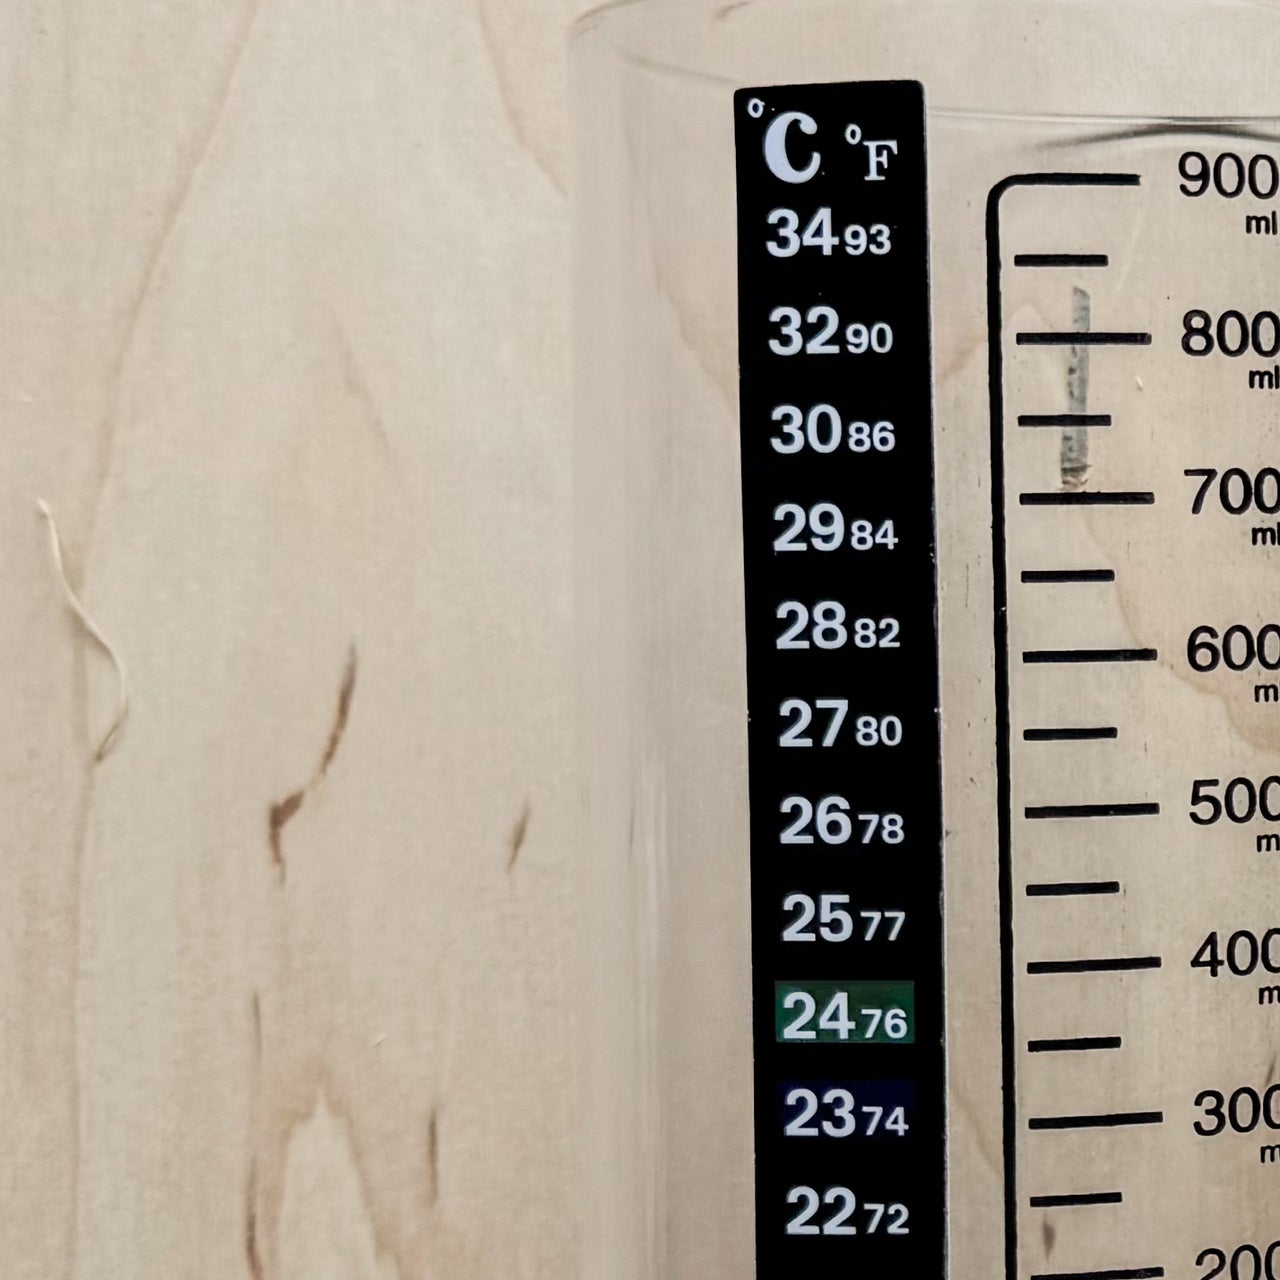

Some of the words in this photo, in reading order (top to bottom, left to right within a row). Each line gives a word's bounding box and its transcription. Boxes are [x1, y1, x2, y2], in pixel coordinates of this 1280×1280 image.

[1176, 150, 1278, 199] 900
[764, 206, 837, 256] 34
[843, 223, 891, 253] 93
[1245, 211, 1277, 234] ml
[766, 305, 839, 354] 32
[845, 322, 893, 353] 90
[1247, 365, 1280, 388] ml
[768, 403, 842, 452] 30
[846, 419, 895, 451] 86
[772, 503, 844, 550] 29
[849, 519, 897, 549] 84
[774, 601, 847, 649] 28
[852, 616, 900, 647] 82
[777, 698, 848, 747] 27
[854, 715, 902, 745] 80
[778, 795, 851, 844] 26
[857, 813, 904, 843] 78
[780, 893, 852, 941] 25
[859, 910, 905, 940] 77
[782, 991, 854, 1039] 24
[859, 1008, 907, 1038] 76
[783, 1087, 856, 1136] 23
[861, 1104, 909, 1135] 74
[785, 1185, 856, 1234] 22
[862, 1202, 909, 1233] 72
